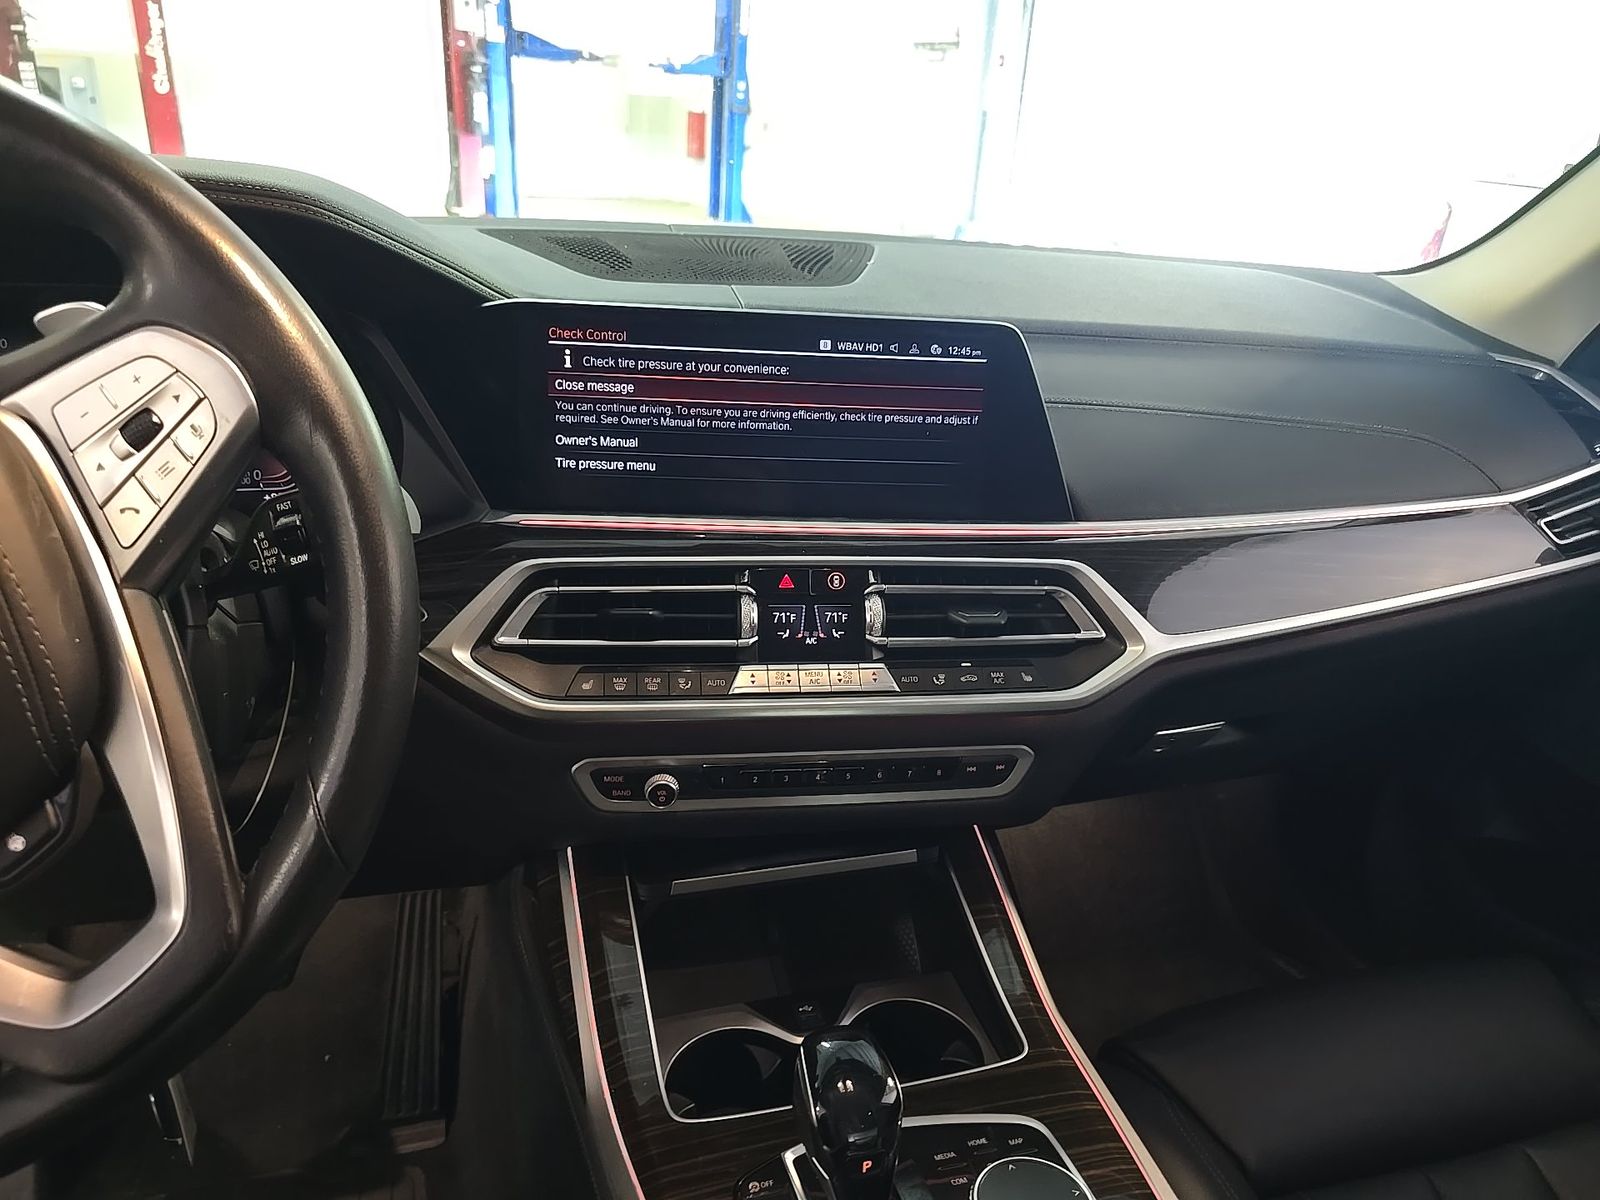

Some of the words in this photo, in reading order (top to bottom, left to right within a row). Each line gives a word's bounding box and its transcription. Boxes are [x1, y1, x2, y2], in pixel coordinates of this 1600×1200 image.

[549, 328, 583, 339] Check
[586, 329, 627, 341] Control
[837, 342, 864, 352] WBAV
[865, 343, 883, 352] HD1
[948, 346, 971, 356] 12:45
[582, 356, 616, 368] Check
[618, 357, 636, 369] tire
[638, 359, 683, 372] pressure
[685, 361, 696, 372] at
[698, 362, 721, 374] your
[723, 363, 790, 375] convenience:
[555, 379, 585, 391] Close
[587, 381, 635, 394] message
[555, 400, 574, 411] You
[576, 402, 593, 411] can
[596, 403, 637, 413] continue
[639, 404, 674, 416] driving.
[676, 405, 688, 415] To
[690, 407, 722, 417] ensure
[723, 408, 741, 419] you
[743, 409, 758, 418] are
[760, 408, 791, 420] driving
[792, 409, 838, 422] efficiently,
[840, 411, 866, 421] check
[868, 412, 882, 422] tire
[884, 413, 923, 424] pressure
[925, 414, 942, 424] and
[943, 414, 971, 426] adjust
[972, 415, 979, 425] if
[555, 414, 599, 424] required.
[600, 414, 619, 424] See
[621, 415, 659, 426] Owner's
[660, 416, 695, 427] Manual
[696, 418, 710, 428] for
[712, 419, 736, 429] more
[738, 419, 793, 431] information.
[555, 434, 598, 447] Owner's
[600, 435, 639, 448] Manual
[555, 457, 576, 469] Tire
[579, 458, 624, 471] pressure
[626, 461, 656, 472] menu
[276, 501, 293, 511] FAST
[260, 541, 269, 549] LO
[265, 557, 278, 566] OFF
[290, 553, 309, 566] SLOW
[707, 679, 726, 687] AUTO
[901, 675, 919, 683] AUTO
[603, 775, 625, 783] MODE
[720, 776, 725, 784] 1
[752, 776, 758, 784] 2
[815, 773, 821, 781] 4
[846, 772, 851, 780] 5
[877, 771, 882, 779] 6
[612, 789, 632, 797] BAND
[967, 1137, 989, 1147] HOME
[934, 1151, 957, 1161] MEDIA
[862, 1160, 873, 1173] P
[760, 1179, 774, 1188] OFF
[950, 1176, 968, 1186] COM
